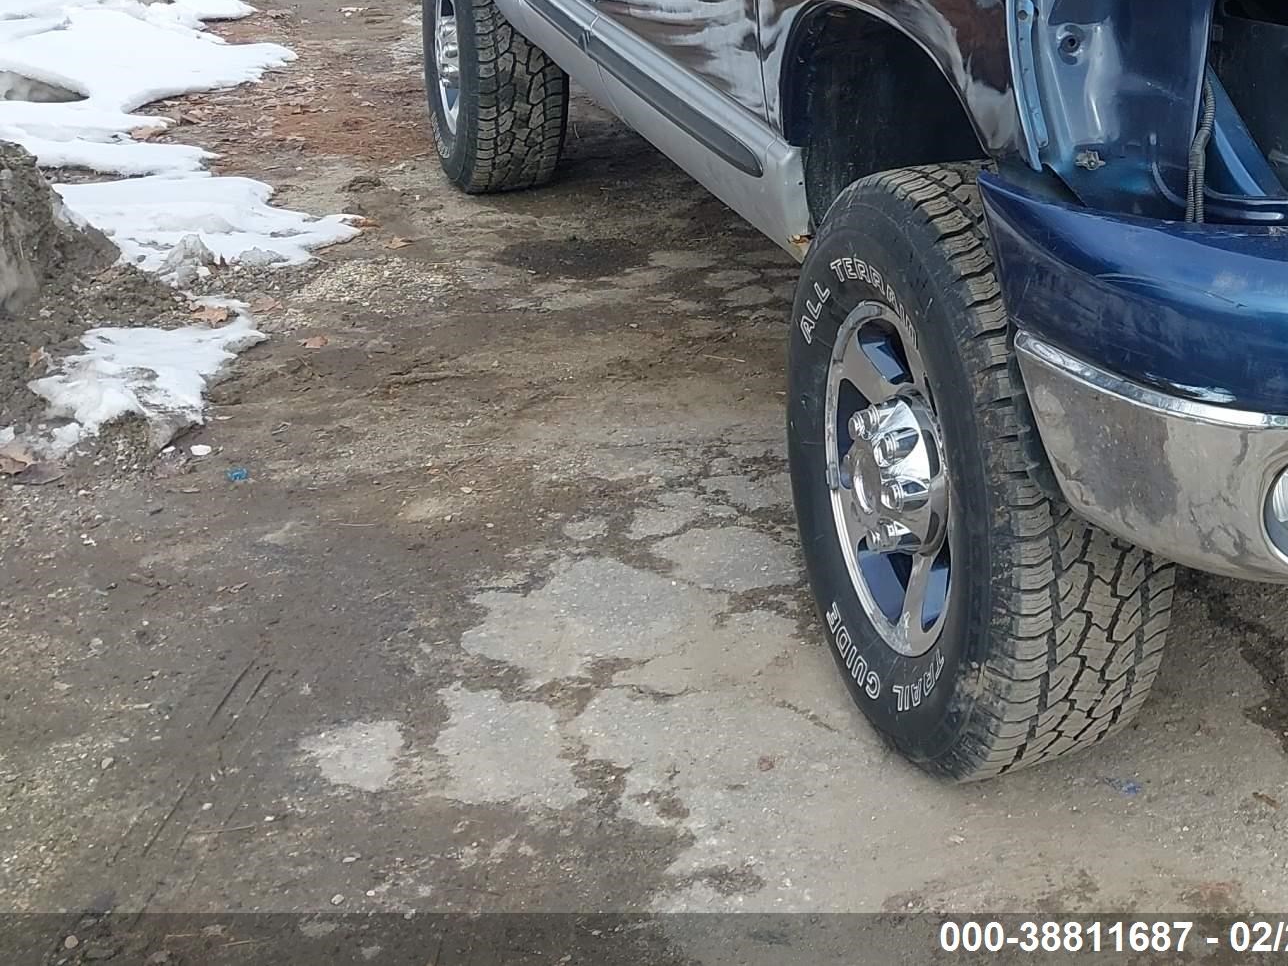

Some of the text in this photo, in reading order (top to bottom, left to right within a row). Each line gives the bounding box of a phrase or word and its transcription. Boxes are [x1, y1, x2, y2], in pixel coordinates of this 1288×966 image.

[800, 281, 831, 345] ALL
[825, 601, 945, 712] TRAIL GUIDE
